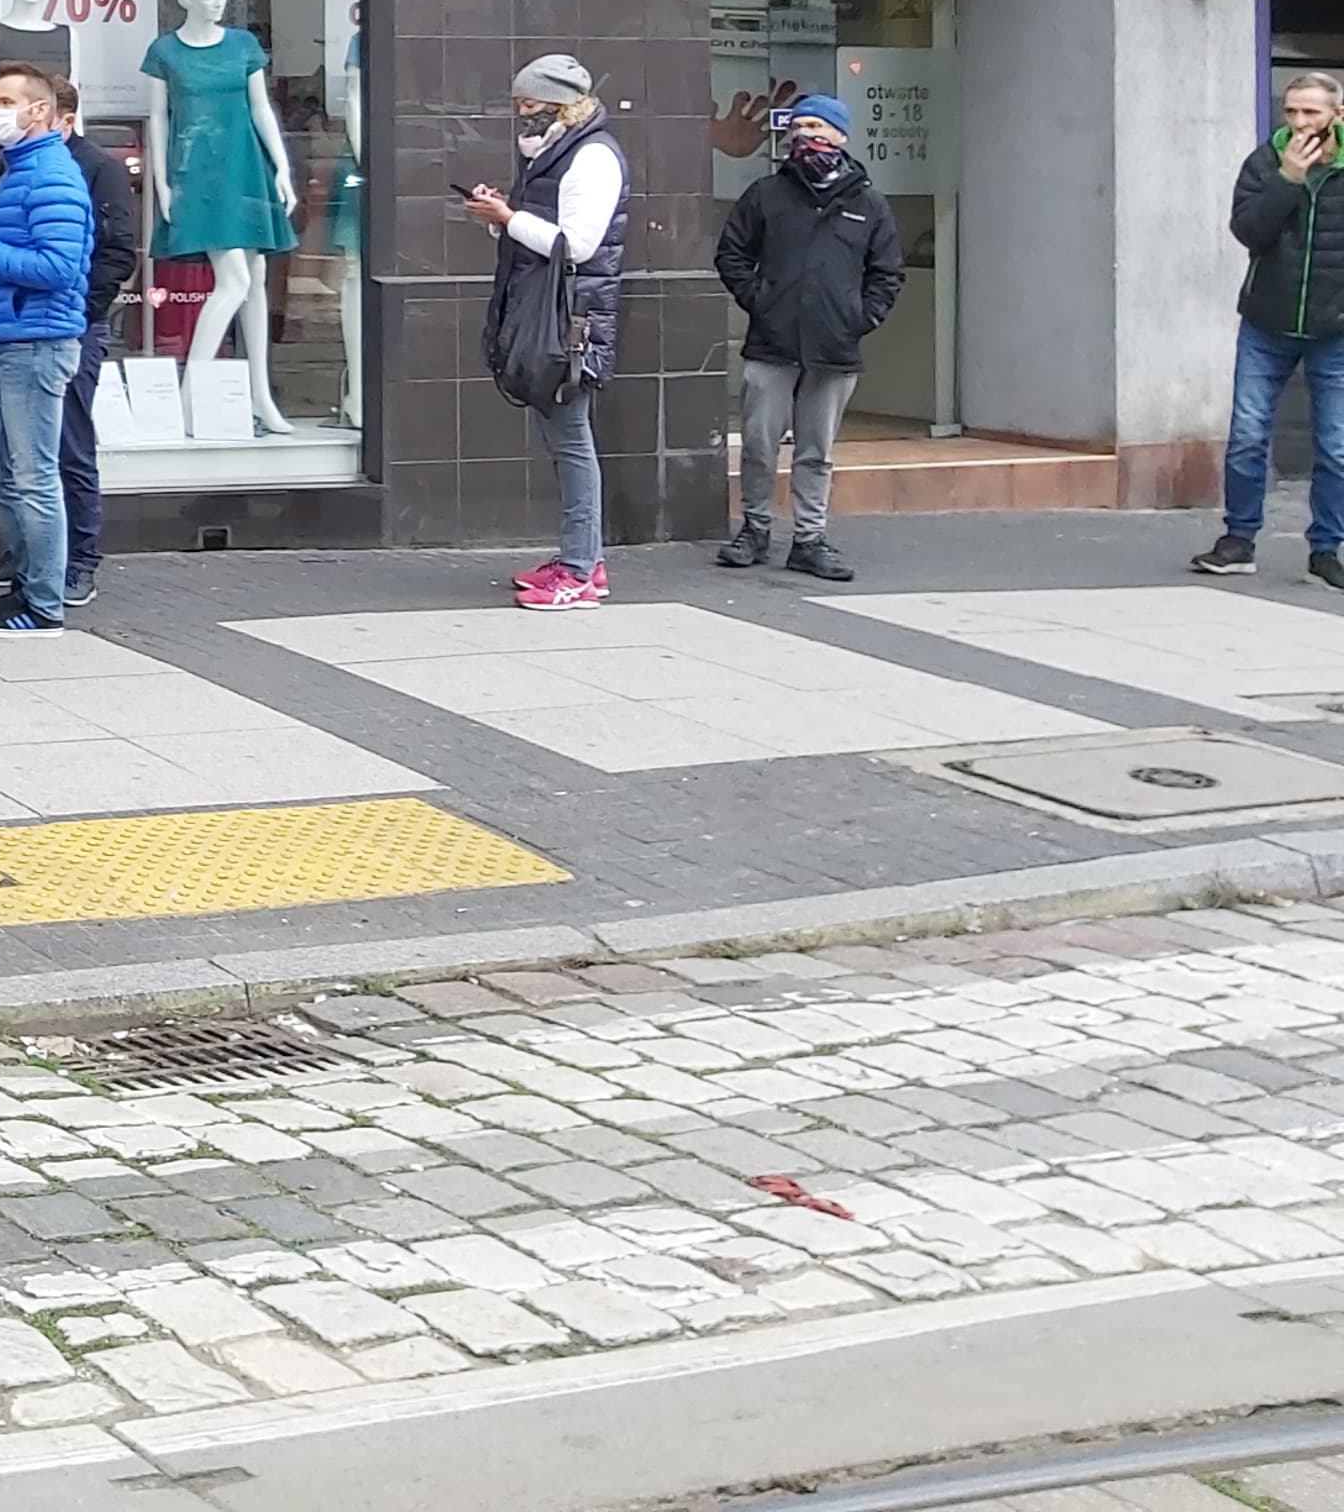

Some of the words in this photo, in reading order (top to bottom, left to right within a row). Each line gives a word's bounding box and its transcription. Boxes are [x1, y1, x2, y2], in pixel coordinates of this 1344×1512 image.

[872, 103, 882, 122] 9
[902, 103, 923, 122] 18
[866, 127, 878, 138] w
[866, 142, 888, 161] 10
[907, 143, 927, 161] 14
[169, 291, 206, 303] POLISH
